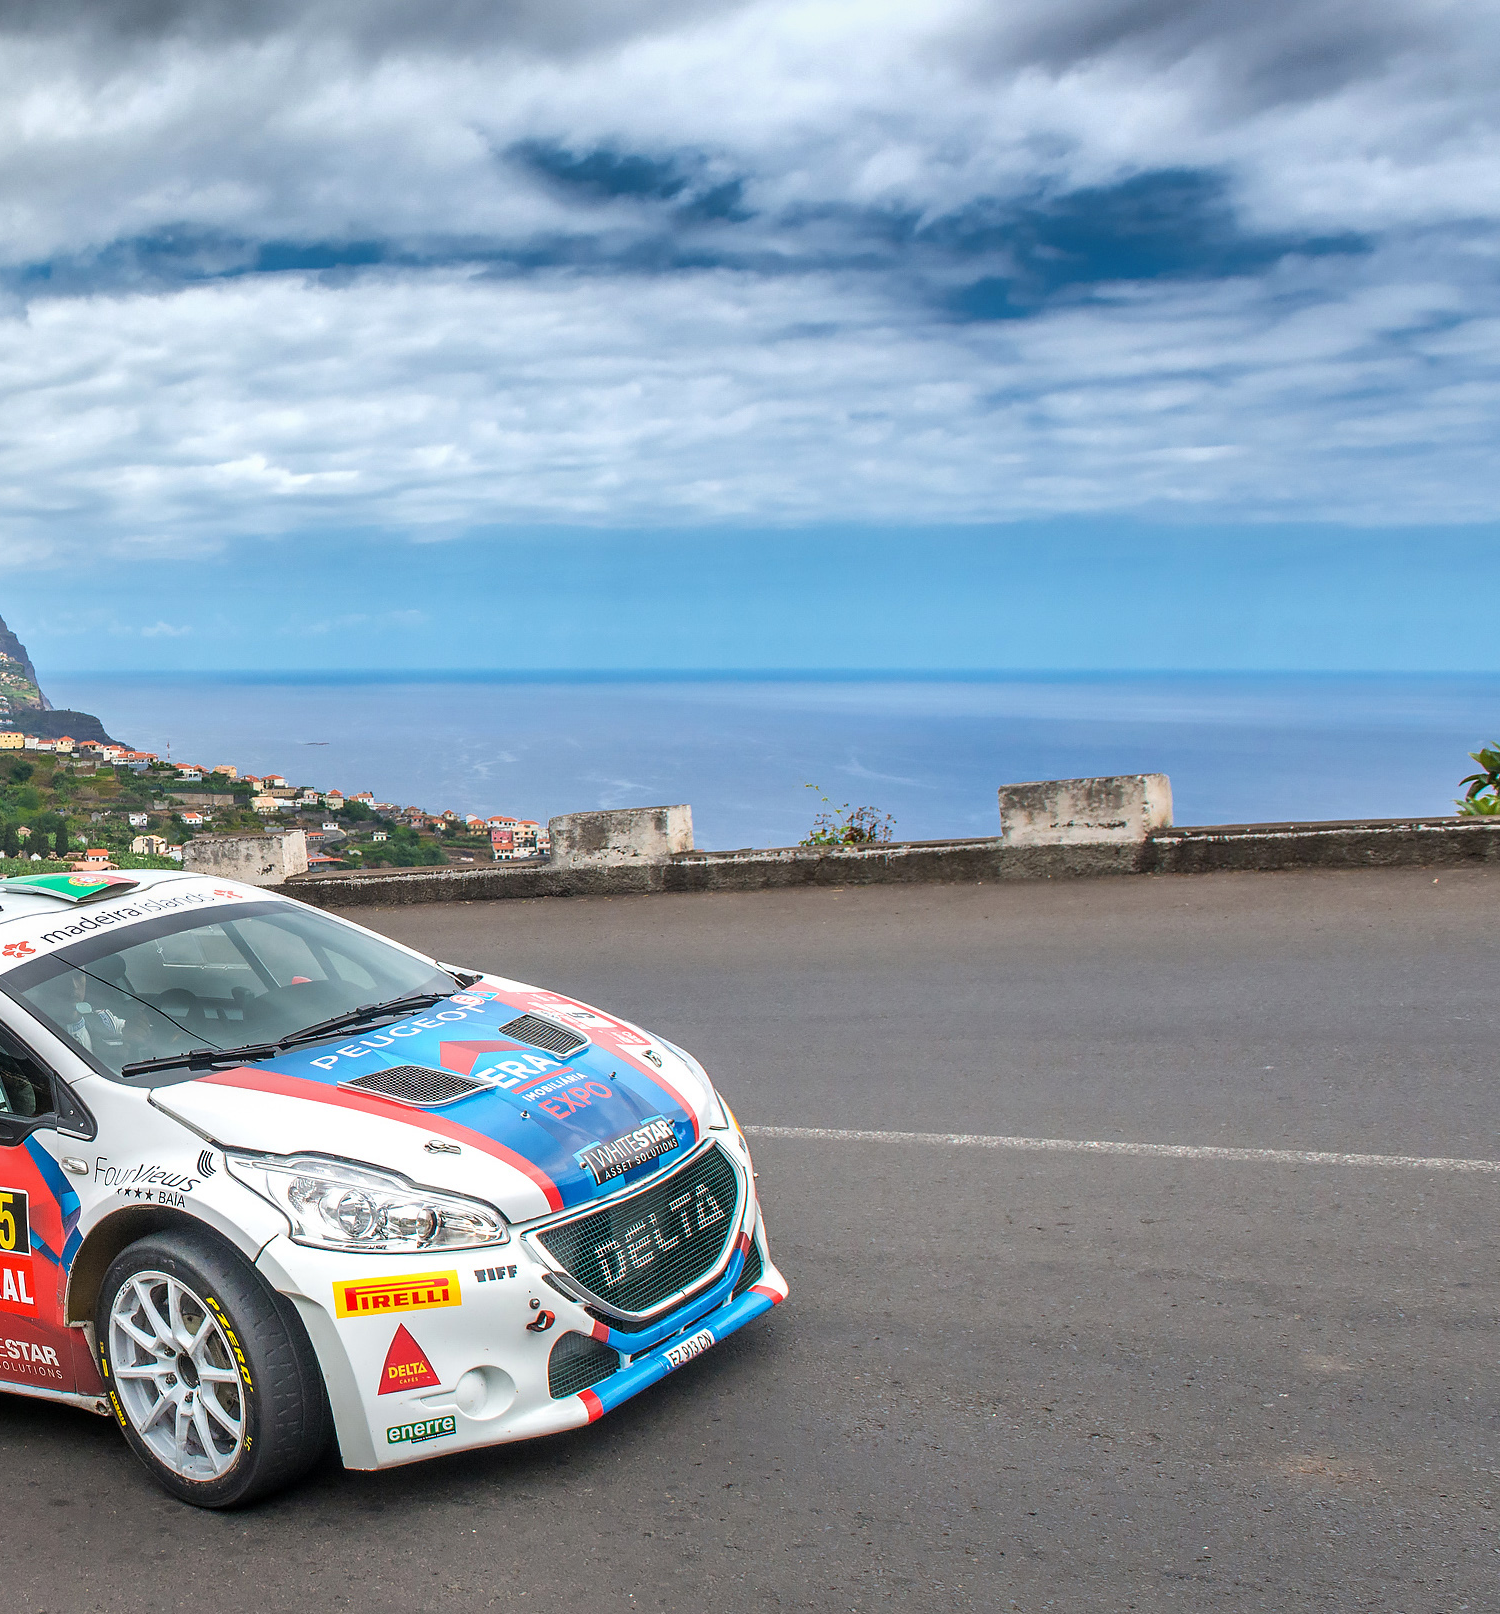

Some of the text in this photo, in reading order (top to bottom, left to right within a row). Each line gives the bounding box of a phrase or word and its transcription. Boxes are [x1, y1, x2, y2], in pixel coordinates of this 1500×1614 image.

[40, 892, 215, 944] madeira islands
[309, 1005, 485, 1070] PEUGEOT
[475, 1054, 563, 1089] ERA
[538, 1081, 613, 1120] EXPO
[590, 1120, 673, 1168] WHITESTAR
[605, 1138, 678, 1180] ASSET SOLUTIONS
[594, 1184, 725, 1288] DELTA
[474, 1264, 518, 1283] TIFF
[344, 1277, 449, 1312] PIRELLI
[668, 1332, 713, 1367] EZ 913 CN
[388, 1360, 428, 1379] DELTA
[388, 1416, 454, 1441] enerre
